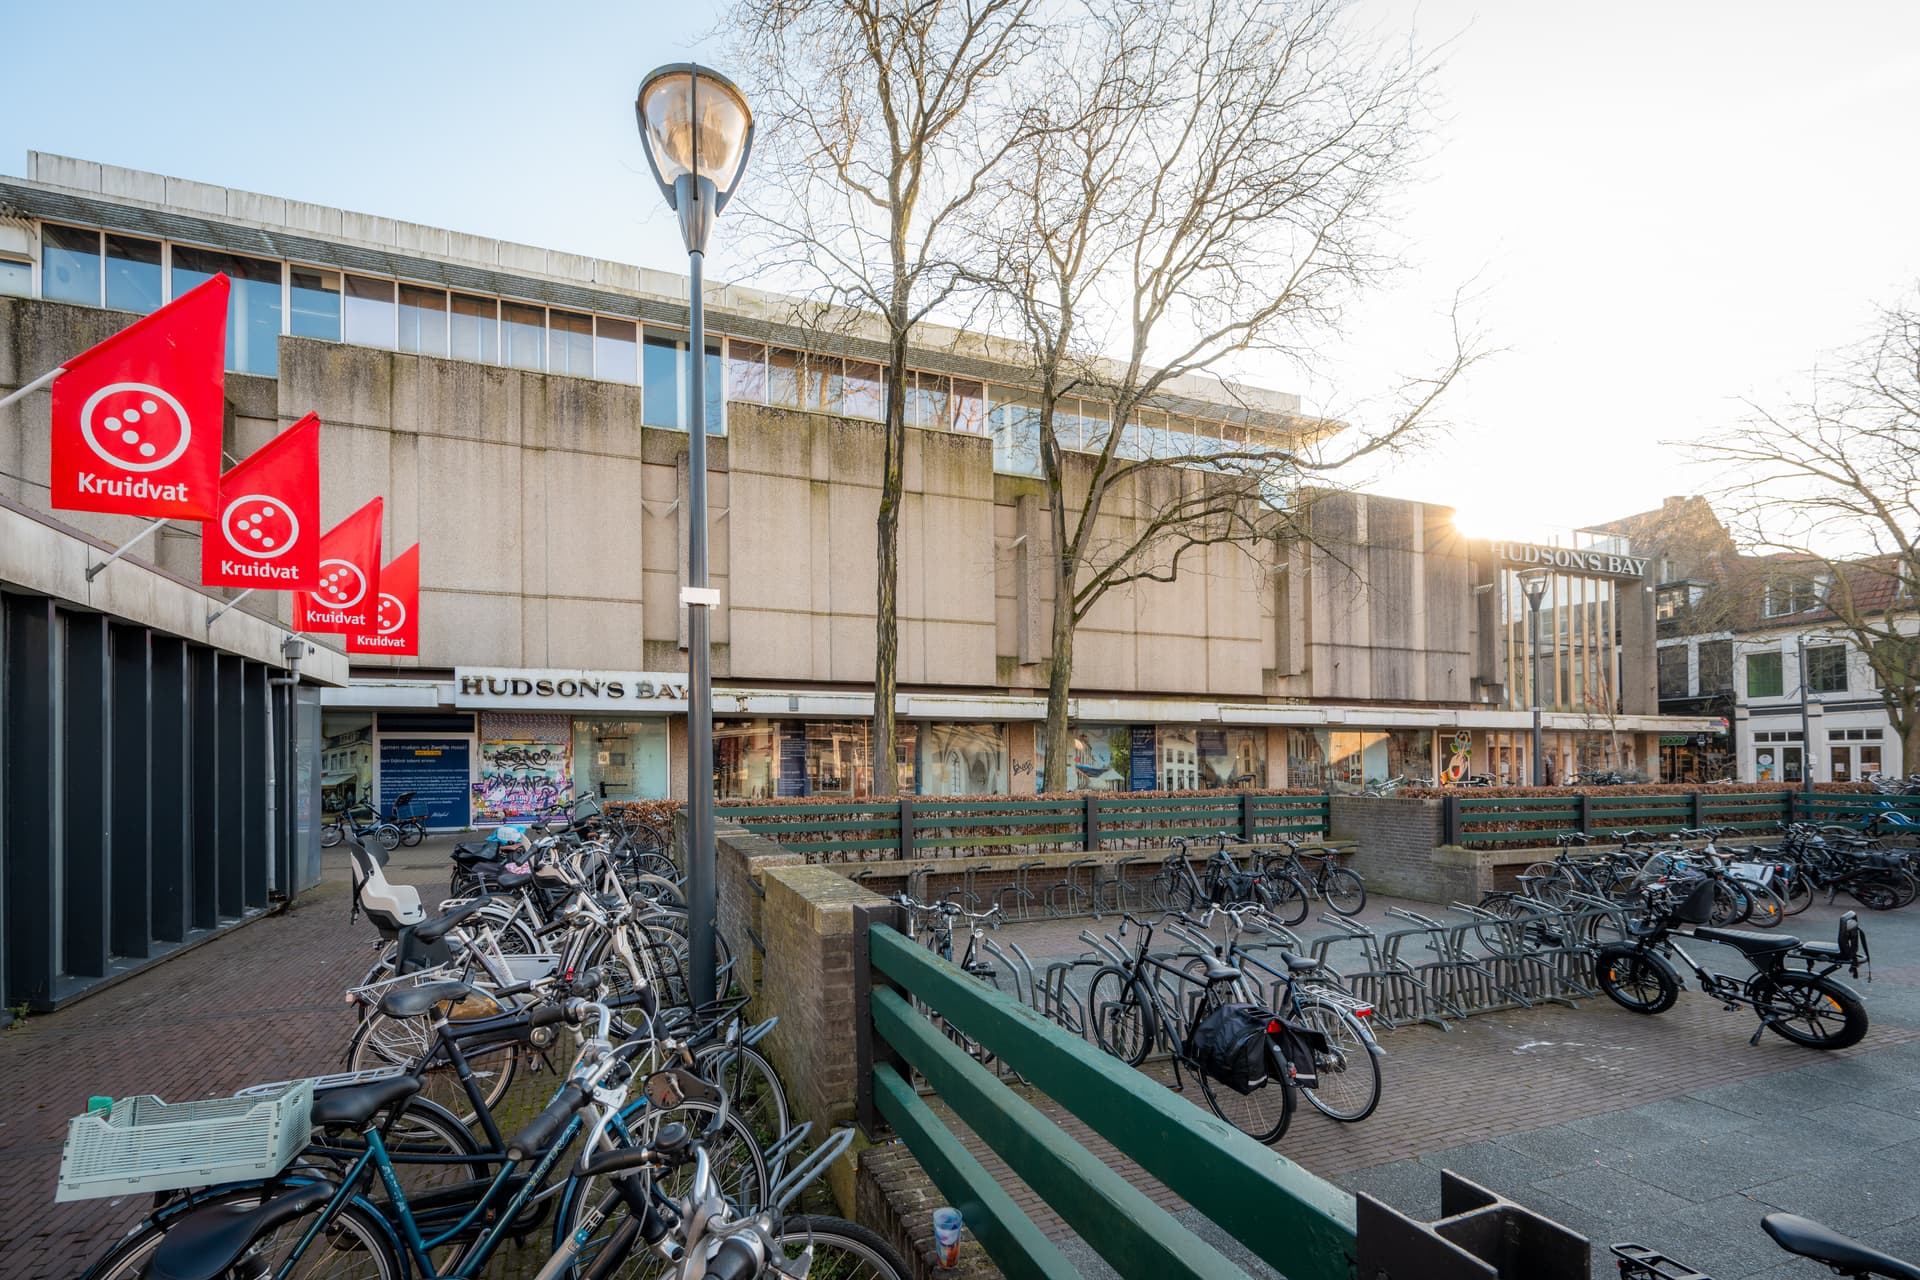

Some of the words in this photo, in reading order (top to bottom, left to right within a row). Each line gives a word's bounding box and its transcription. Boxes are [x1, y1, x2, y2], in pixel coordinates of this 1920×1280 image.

[78, 472, 188, 503] Kruidvat
[221, 560, 300, 580] Kruidvat
[1491, 542, 1602, 571] HUDSON'S
[1607, 556, 1647, 577] BAY
[306, 610, 366, 626] Kruidvat
[357, 634, 406, 648] Kruidvat
[460, 675, 625, 699] HUDSON'S
